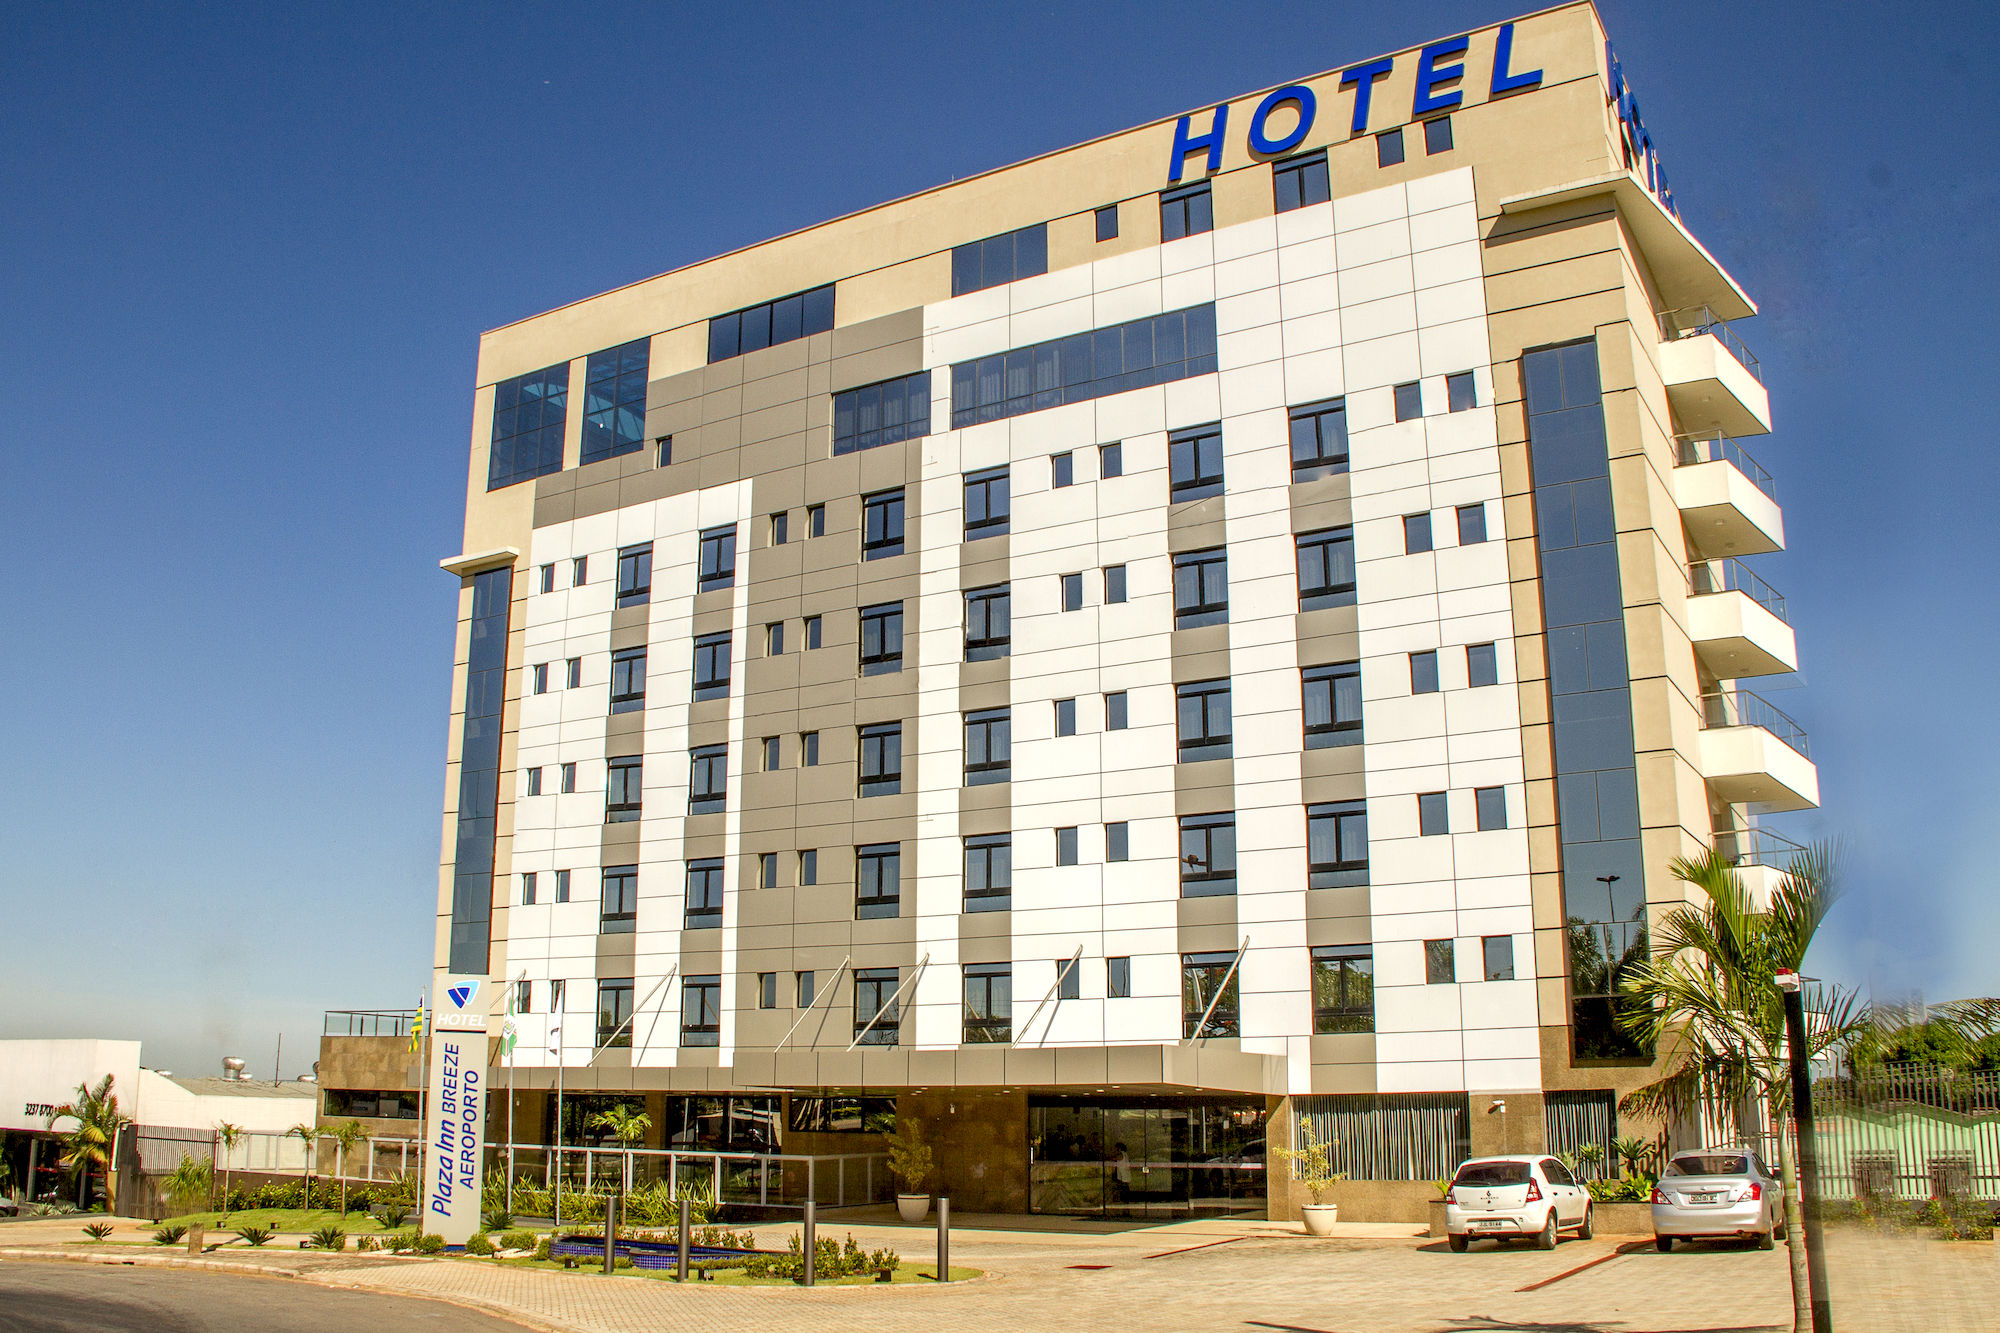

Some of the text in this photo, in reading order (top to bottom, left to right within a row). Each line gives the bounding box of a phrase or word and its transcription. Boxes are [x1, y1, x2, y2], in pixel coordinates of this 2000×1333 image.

[1168, 23, 1543, 181] HOTEL
[437, 1013, 487, 1026] HOTEL
[432, 1042, 459, 1216] Plaza Inn BREEZE
[460, 1070, 479, 1190] AEROPORTO
